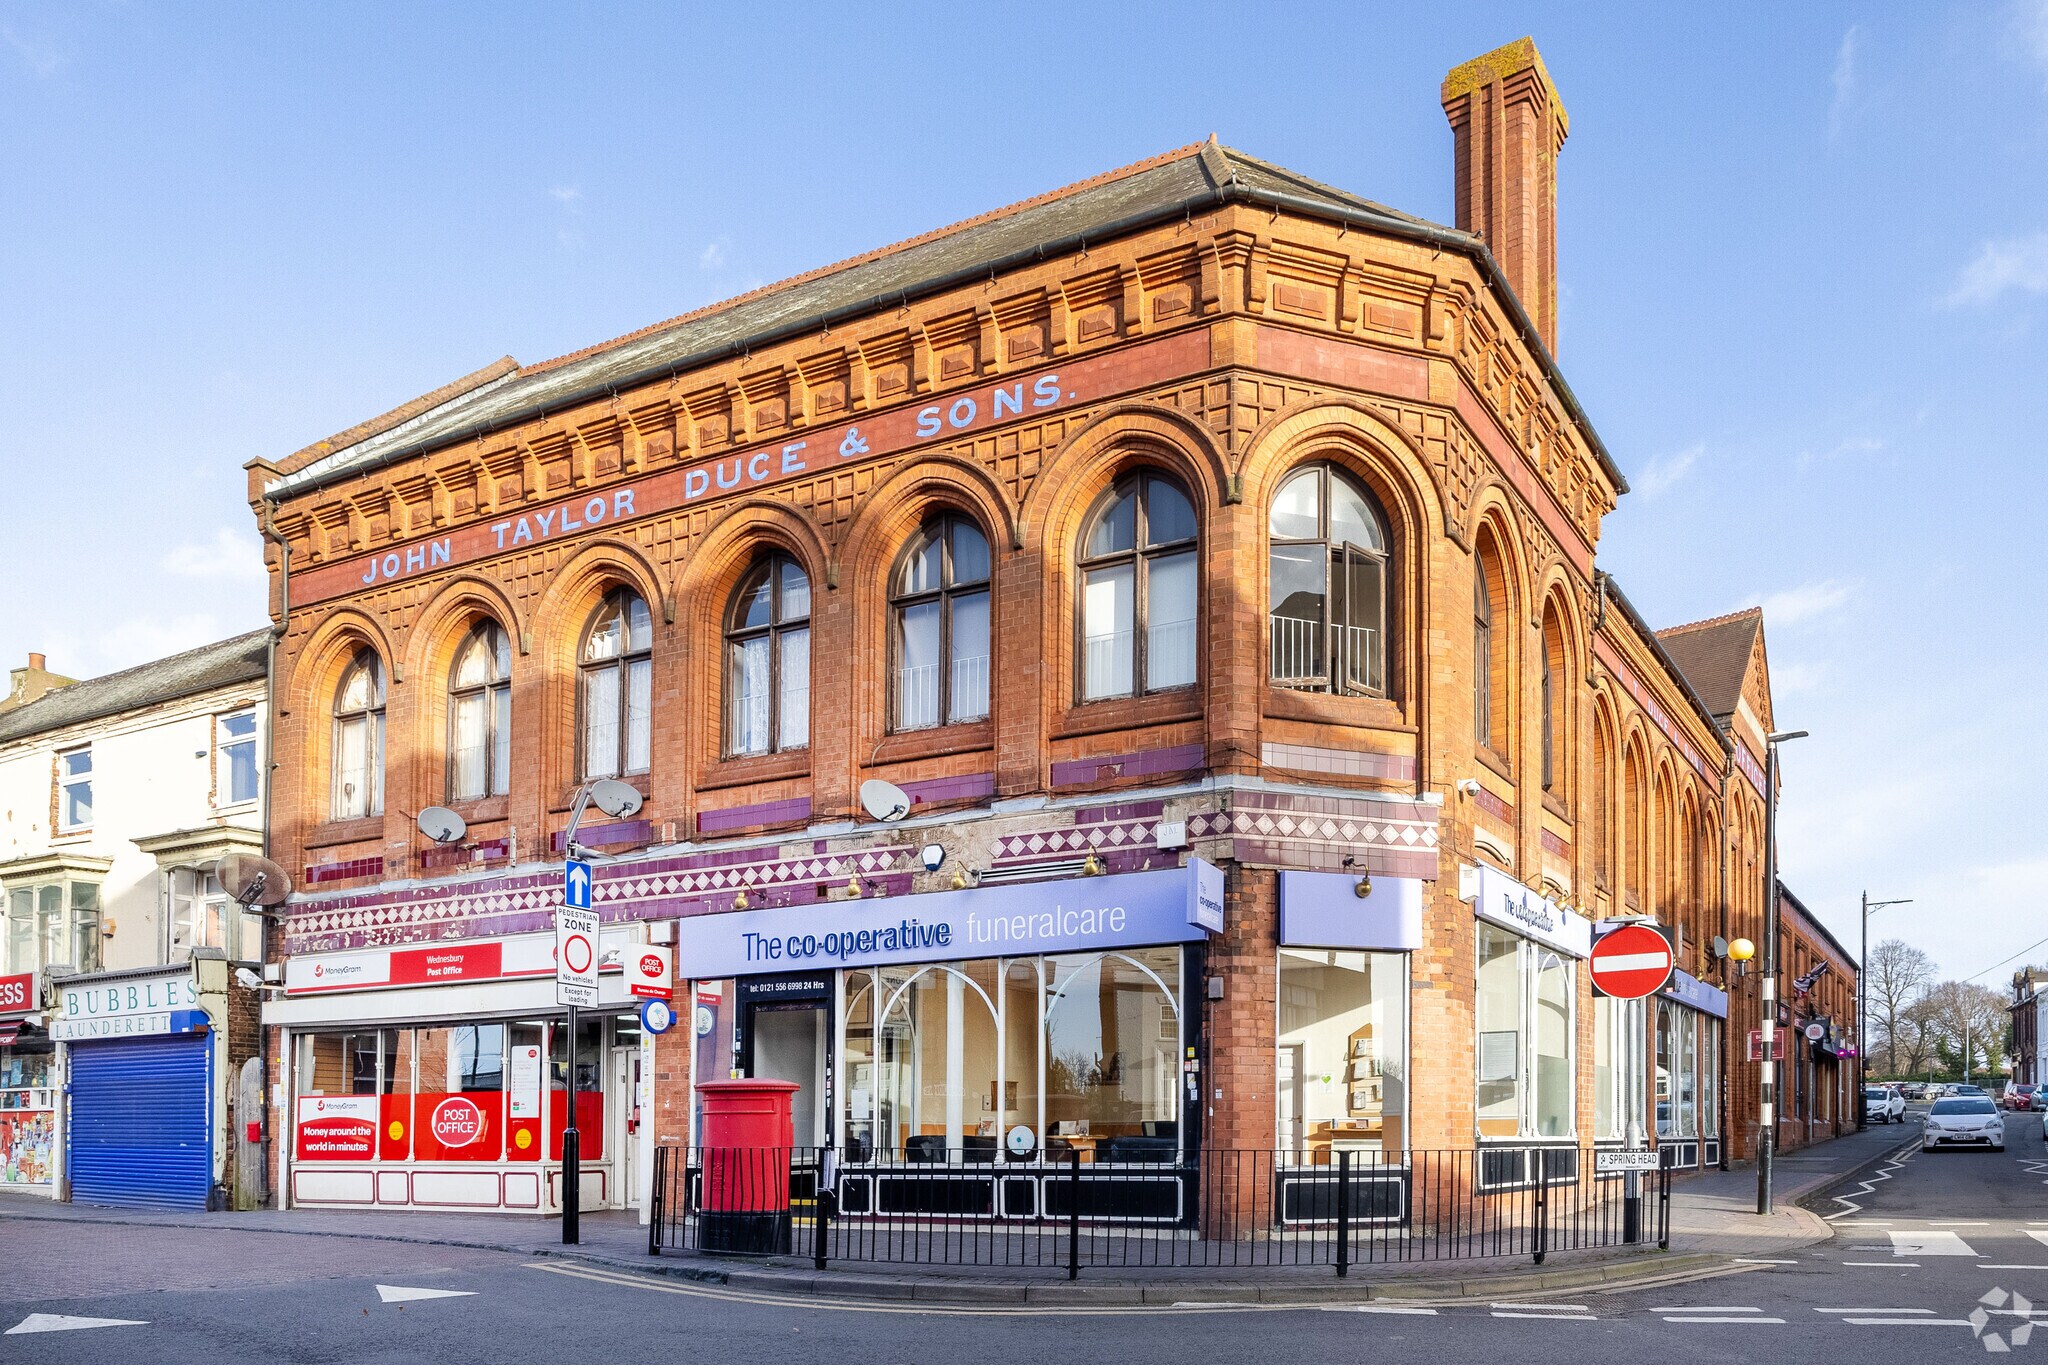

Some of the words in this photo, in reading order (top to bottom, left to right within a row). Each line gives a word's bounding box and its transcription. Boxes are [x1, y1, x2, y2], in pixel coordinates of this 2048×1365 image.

[362, 538, 450, 584] JOHN
[491, 489, 635, 549] TAYLOR
[685, 441, 807, 499] DUCE
[839, 427, 870, 457] &
[916, 374, 1077, 437] SONS.
[1503, 893, 1515, 916] The
[558, 908, 598, 921] PEDESTRIAN
[564, 919, 592, 932] ZONE
[742, 932, 782, 961] The
[786, 917, 953, 960] co-operative
[966, 905, 1126, 943] funeralcare
[426, 954, 464, 965] Wednesbury
[645, 958, 660, 966] POST
[324, 965, 362, 975] MoneyGram
[427, 967, 441, 976] Post
[443, 966, 462, 976] Office
[642, 965, 661, 973] OFFICE
[572, 976, 593, 984] vehicles
[564, 987, 582, 996] Except
[584, 989, 592, 997] for
[750, 985, 758, 993] tel:
[760, 983, 774, 992] 0121
[775, 982, 787, 991] 556
[787, 981, 803, 990] 6998
[803, 981, 812, 989] 24
[813, 980, 825, 989] Hrs
[67, 979, 197, 1016] BUBBLES
[568, 995, 588, 1004] loading
[56, 1015, 169, 1038] LAUNDERETT
[325, 1102, 358, 1111] MoneyGram
[443, 1109, 471, 1121] POST
[303, 1126, 328, 1138] Money
[328, 1126, 356, 1136] around
[357, 1126, 371, 1136] the
[437, 1122, 474, 1134] OFFICE
[305, 1142, 328, 1151] world
[328, 1142, 335, 1151] in
[336, 1141, 368, 1151] minutes
[1609, 1154, 1636, 1164] SPRING
[1638, 1154, 1657, 1164] HEAD
